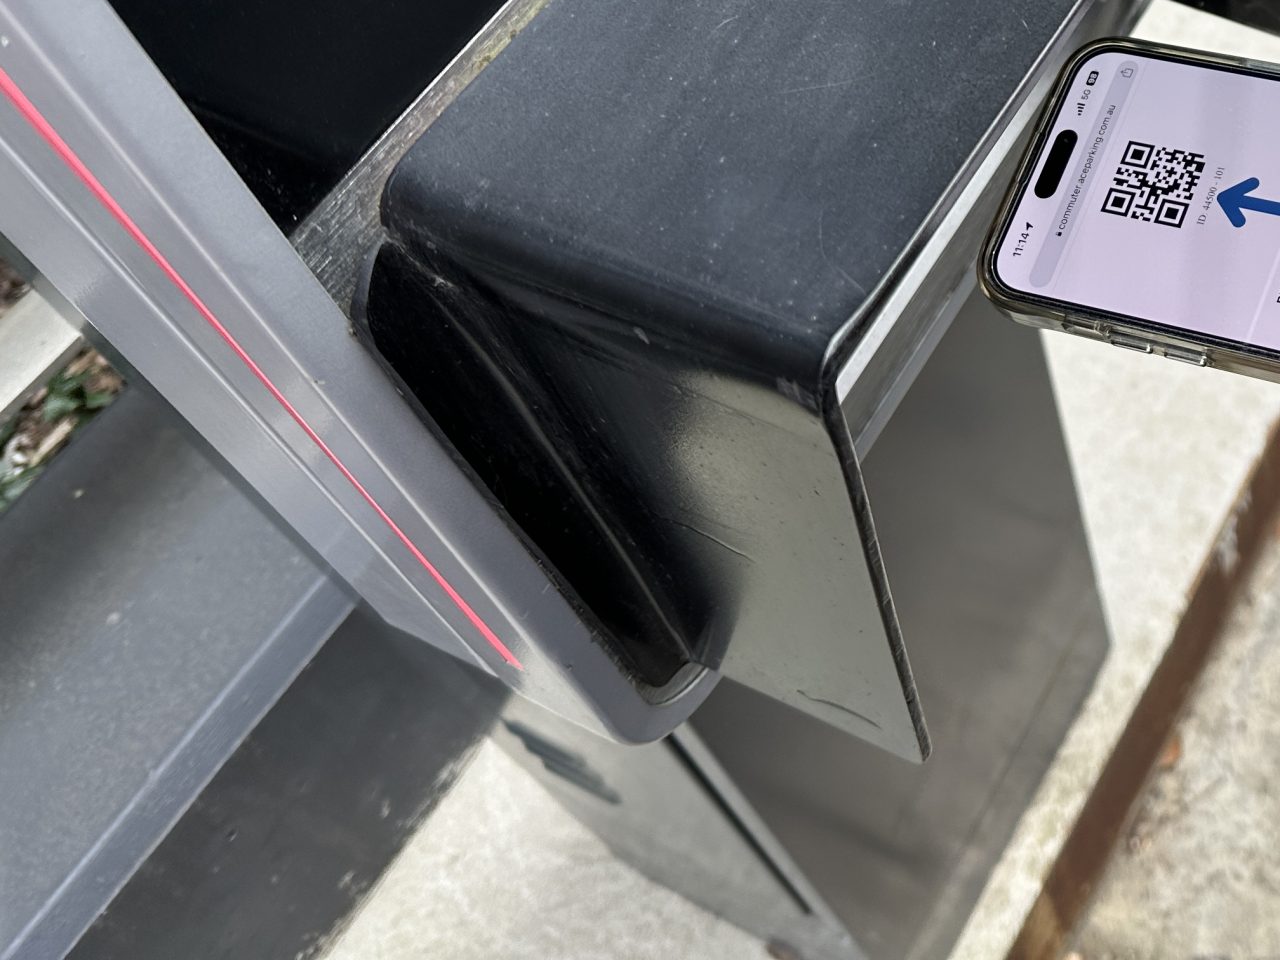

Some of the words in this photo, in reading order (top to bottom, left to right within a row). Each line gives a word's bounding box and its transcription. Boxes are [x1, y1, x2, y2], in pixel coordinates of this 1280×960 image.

[1081, 89, 1091, 100] 5G
[1059, 104, 1116, 230] commuter.aceparking.com.au
[1013, 232, 1030, 257] 11:14
